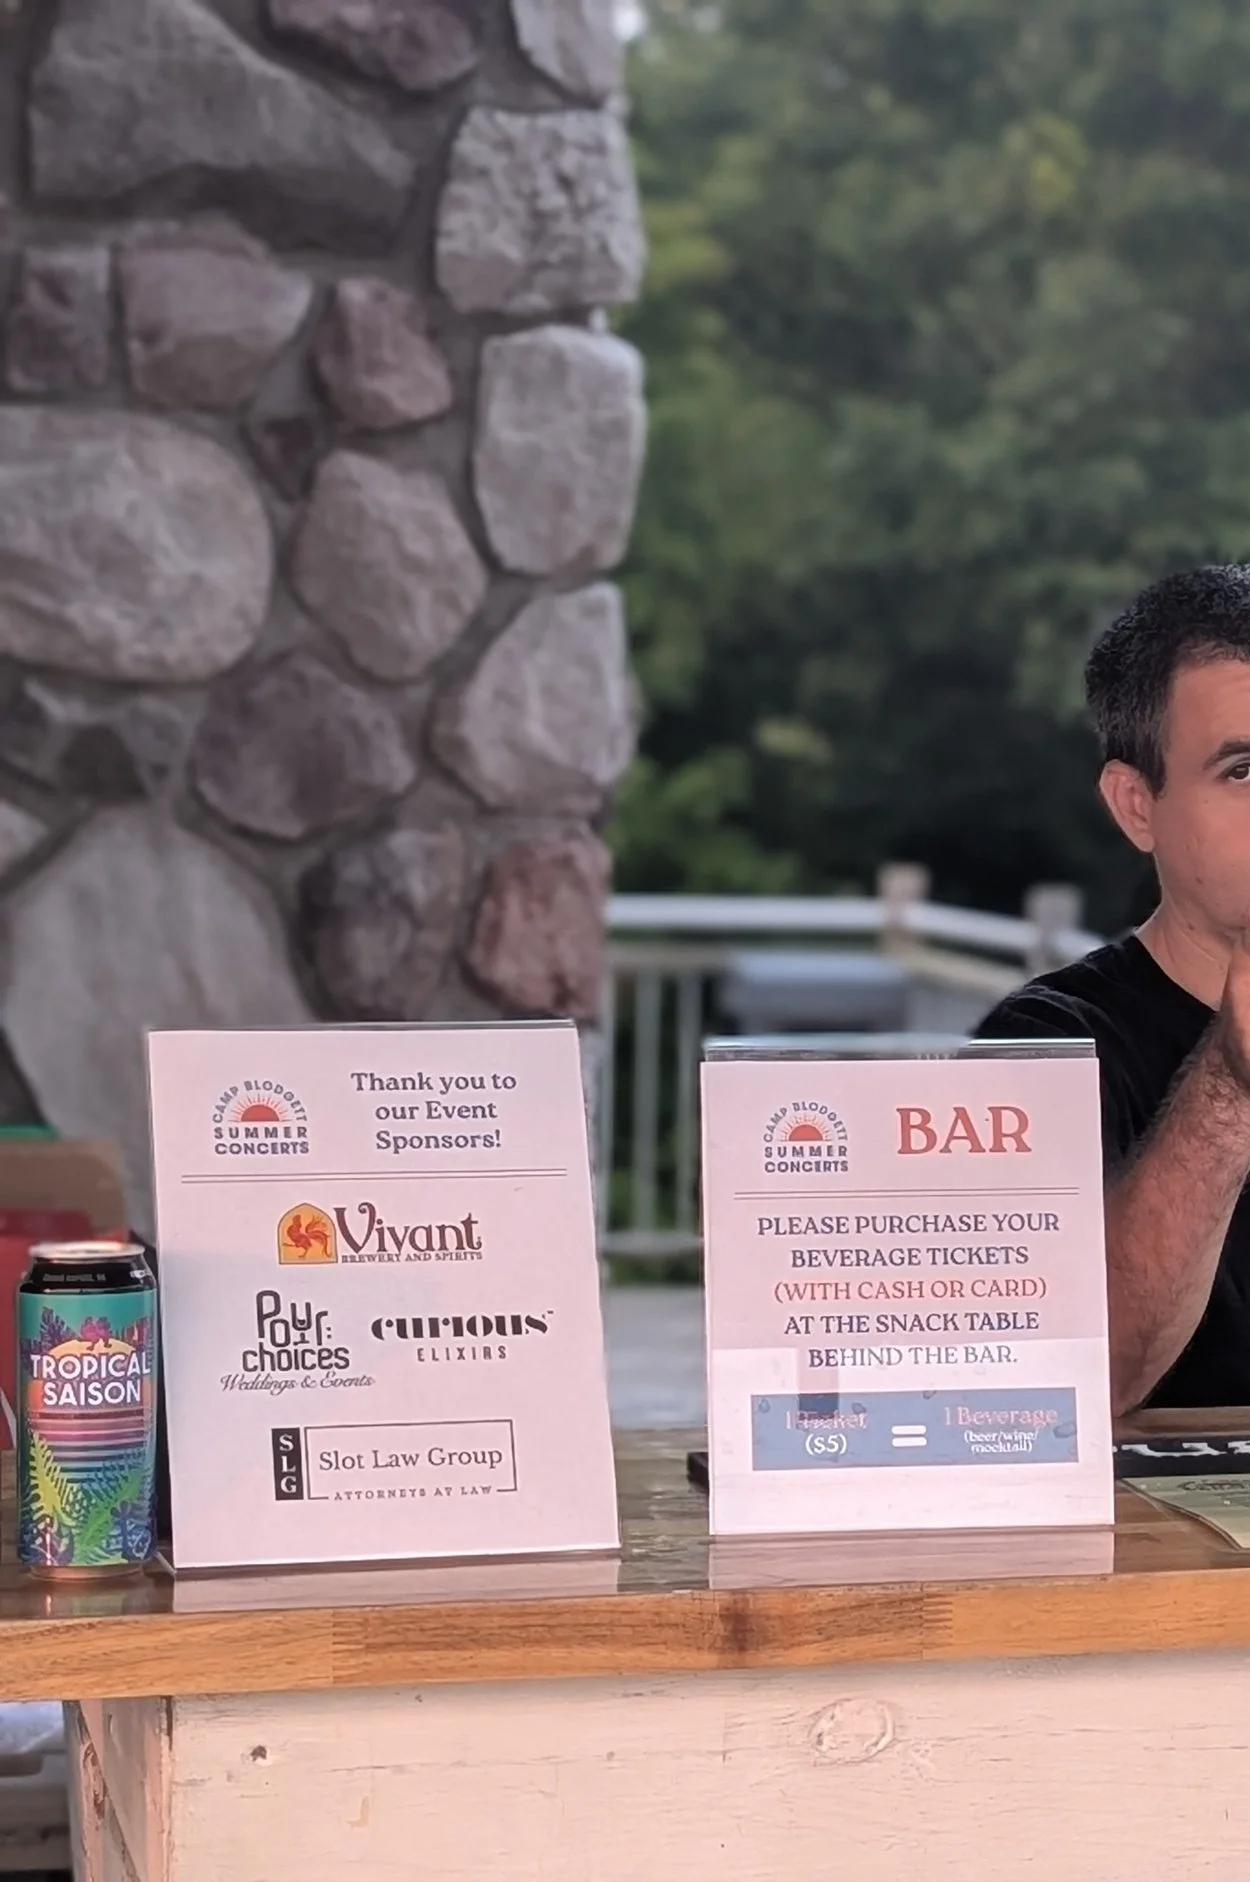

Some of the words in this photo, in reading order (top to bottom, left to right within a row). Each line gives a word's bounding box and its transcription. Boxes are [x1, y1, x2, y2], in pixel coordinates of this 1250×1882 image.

[350, 1071, 431, 1092] Thank
[438, 1074, 486, 1094] you
[491, 1072, 517, 1091] to
[212, 1086, 239, 1123] CAMP
[244, 1080, 307, 1122] BLODGETT
[375, 1103, 419, 1121] our
[426, 1101, 498, 1120] Event
[213, 1126, 308, 1140] SUMMER
[763, 1107, 788, 1142] CAMP
[792, 1101, 848, 1140] BLODGETT
[896, 1106, 1032, 1154] BAR
[214, 1141, 310, 1155] CONCERTS
[375, 1128, 502, 1154] Sponsors!
[764, 1145, 848, 1158] SUMMER
[764, 1160, 849, 1173] CONCERTS
[333, 1202, 482, 1253] Vivant
[757, 1215, 850, 1236] PLEASE
[855, 1214, 988, 1235] PURCHASE
[992, 1212, 1060, 1232] YOUR
[341, 1252, 401, 1264] BREWERY
[405, 1251, 432, 1262] AND
[435, 1250, 483, 1261] SPIRITS
[791, 1247, 921, 1268] BEVERAGE
[927, 1246, 1029, 1266] TICKETS
[774, 1281, 851, 1303] (WITH
[857, 1279, 926, 1300] CASH
[930, 1279, 966, 1299] OR
[970, 1277, 1048, 1299] CARD)
[784, 1315, 814, 1335] AT
[820, 1314, 870, 1334] THE
[875, 1313, 960, 1333] SNACK
[964, 1311, 1040, 1331] TABLE
[242, 1342, 350, 1373] choices
[417, 1346, 507, 1362] ELIXIRS
[808, 1347, 902, 1368] BEHIND
[909, 1345, 958, 1365] THE
[963, 1344, 1018, 1364] BAR.
[30, 1353, 152, 1380] TROPICAL
[42, 1381, 141, 1406] SAISON
[220, 1373, 297, 1396] Weddings
[301, 1375, 317, 1389] &
[320, 1371, 376, 1388] Events
[957, 1405, 1058, 1427] Beverage
[805, 1433, 847, 1456] ($5)
[319, 1450, 365, 1471] Slot
[372, 1450, 419, 1469] Law
[428, 1447, 503, 1469] Group
[334, 1488, 426, 1500] ATTORNEYS
[434, 1487, 453, 1497] AT
[460, 1485, 493, 1496] LAW
